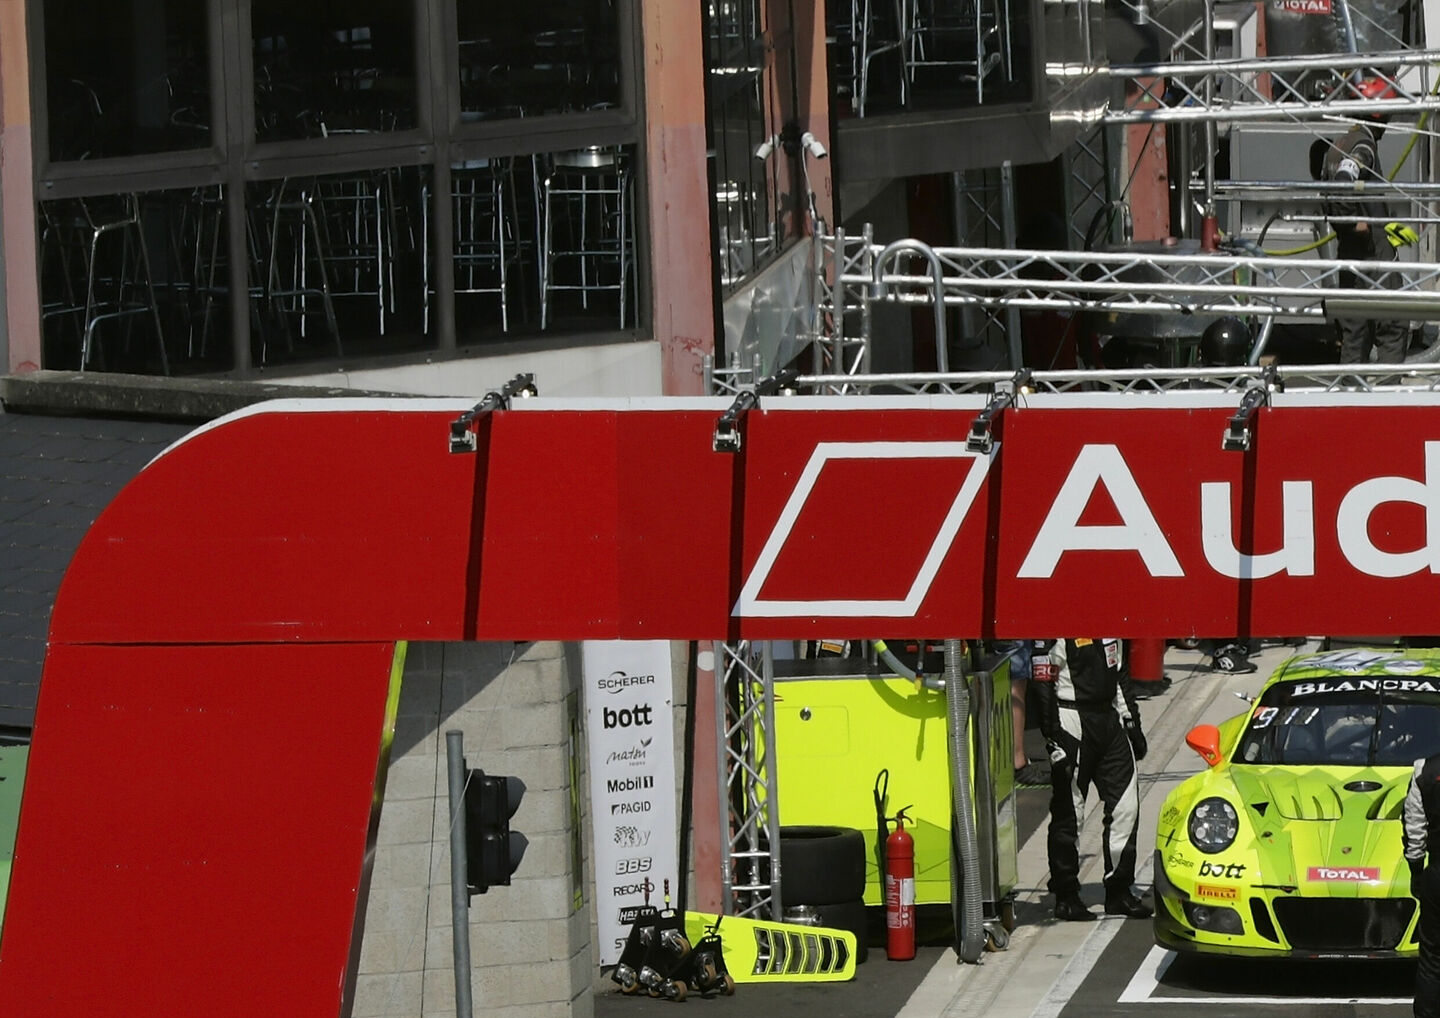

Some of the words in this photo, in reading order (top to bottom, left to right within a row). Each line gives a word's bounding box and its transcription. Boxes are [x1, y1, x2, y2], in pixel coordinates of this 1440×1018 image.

[598, 675, 655, 689] SCHERER
[603, 703, 653, 729] bott
[1253, 706, 1320, 729] 911
[607, 777, 642, 793] Mobil
[620, 801, 652, 814] PAGID
[615, 858, 653, 875] BBS
[1198, 861, 1247, 878] bott
[1318, 868, 1369, 880] TOTAL
[614, 882, 655, 897] RECARO
[1198, 884, 1237, 899] PIRELLI
